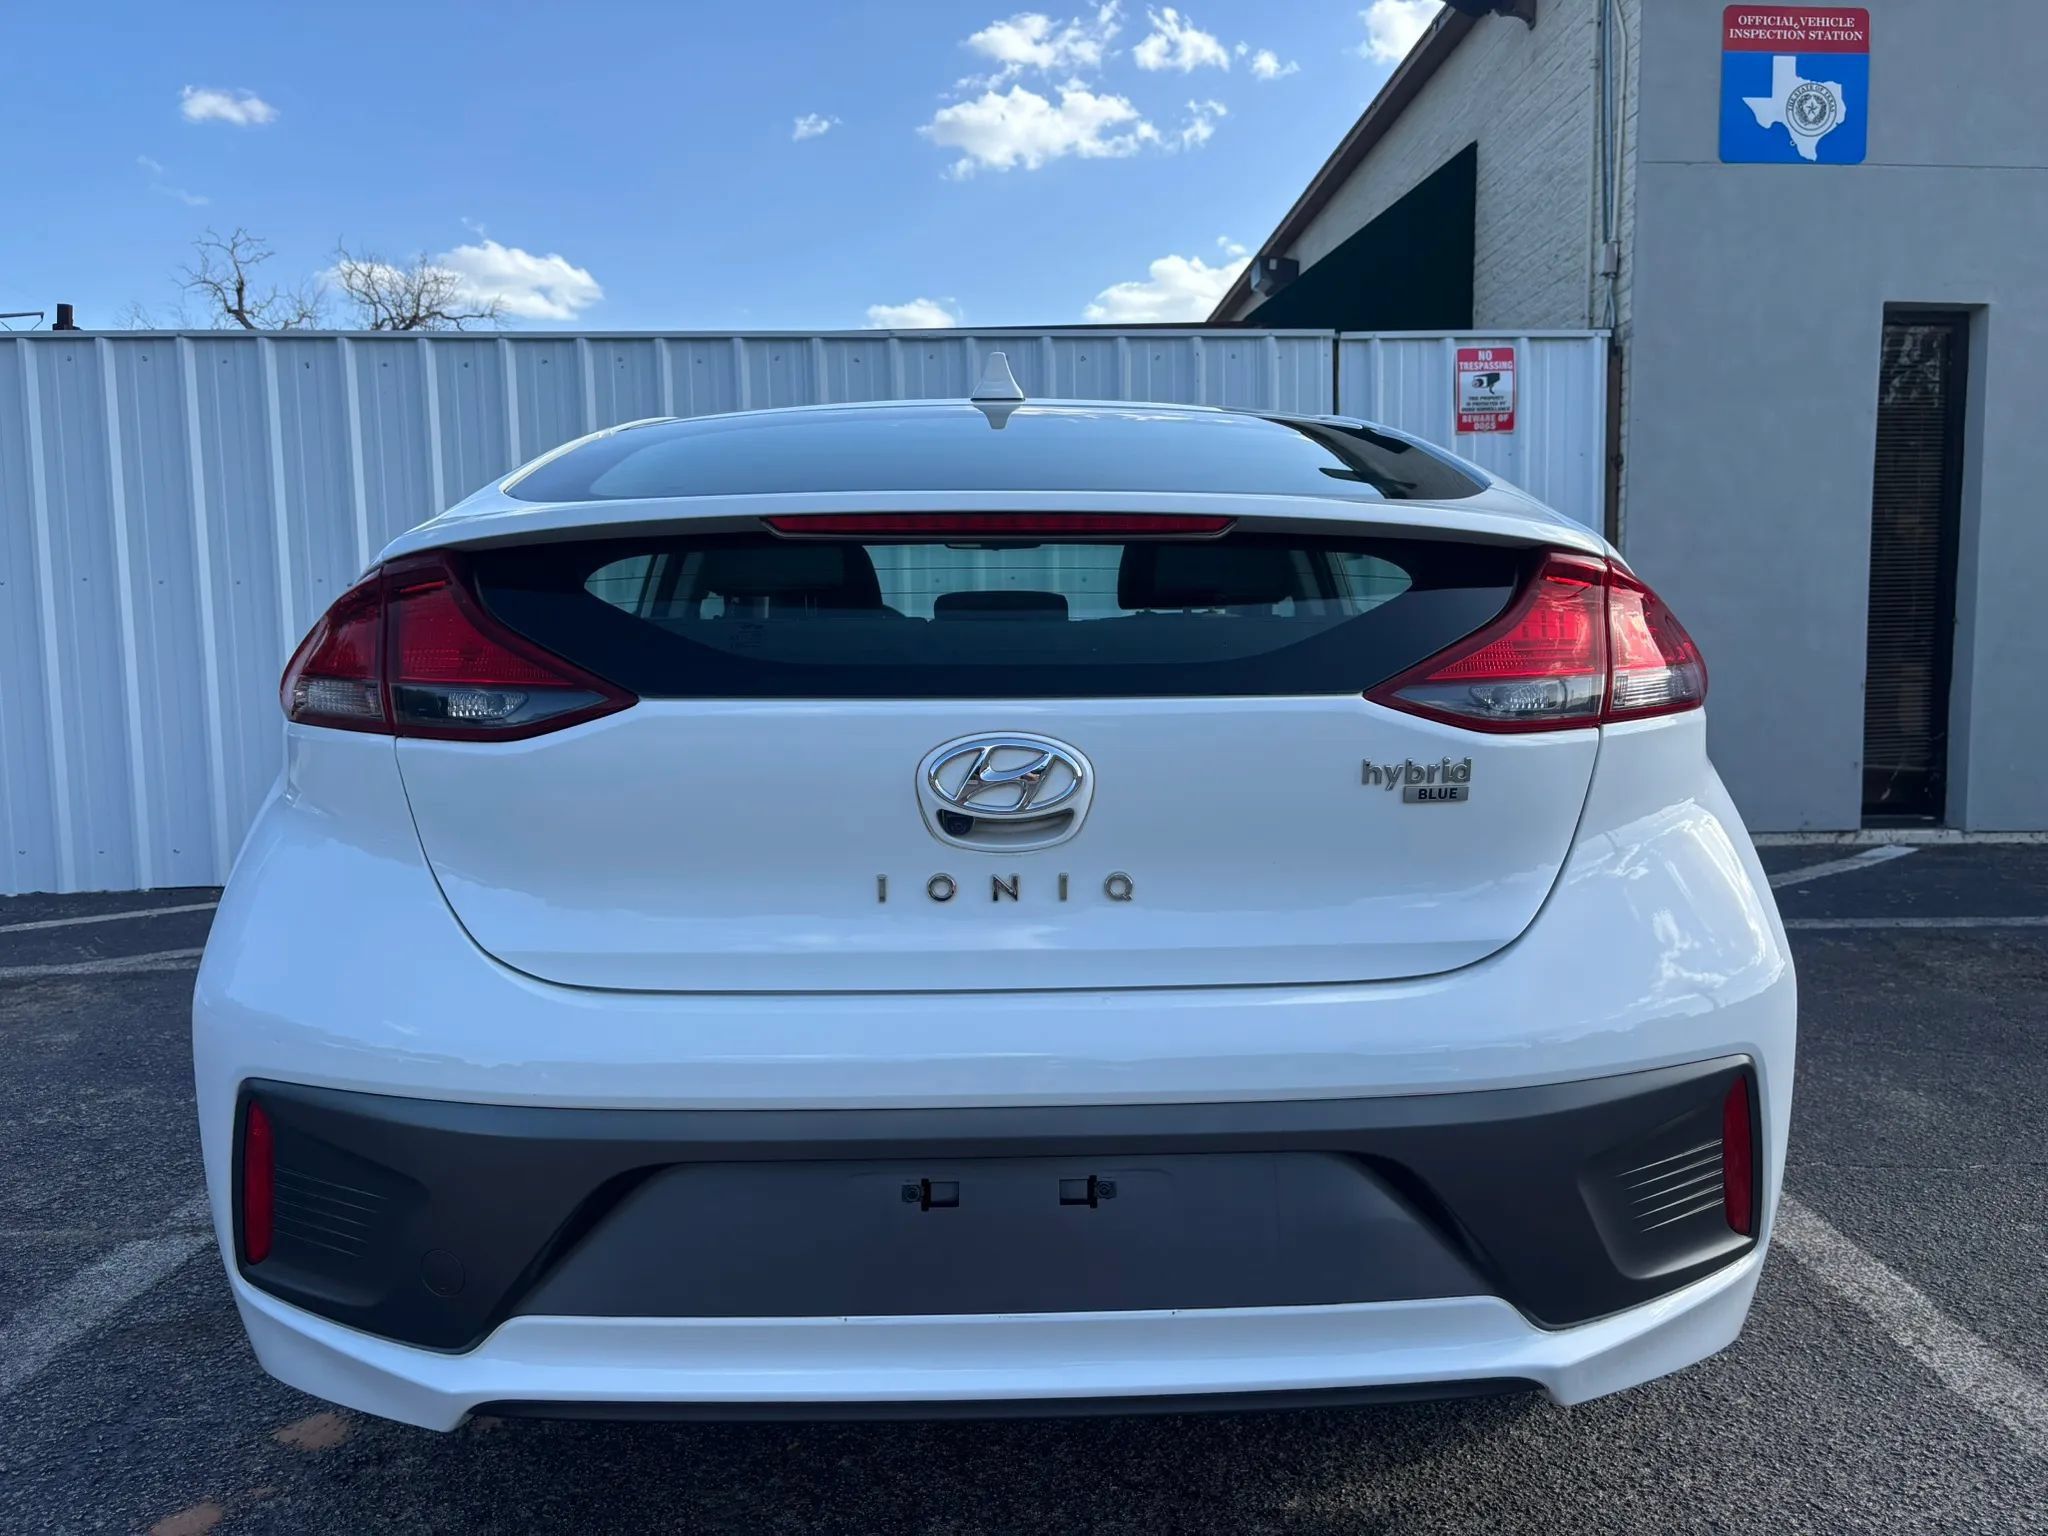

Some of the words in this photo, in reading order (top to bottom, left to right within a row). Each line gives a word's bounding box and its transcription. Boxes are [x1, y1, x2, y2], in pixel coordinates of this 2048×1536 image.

[1738, 15, 1794, 26] OFFICIAL
[1799, 17, 1855, 28] VEHICLE
[1729, 28, 1806, 40] INSPECTION
[1808, 30, 1863, 41] STATION
[1478, 350, 1493, 360] NO
[1459, 361, 1513, 370] TRESPASSING
[1462, 414, 1496, 423] BEWARE
[1498, 413, 1509, 422] OF
[1474, 422, 1497, 430] DOGS
[1361, 756, 1472, 791] hybrid
[1418, 788, 1458, 800] BLUE
[876, 871, 1134, 902] IONIQ
